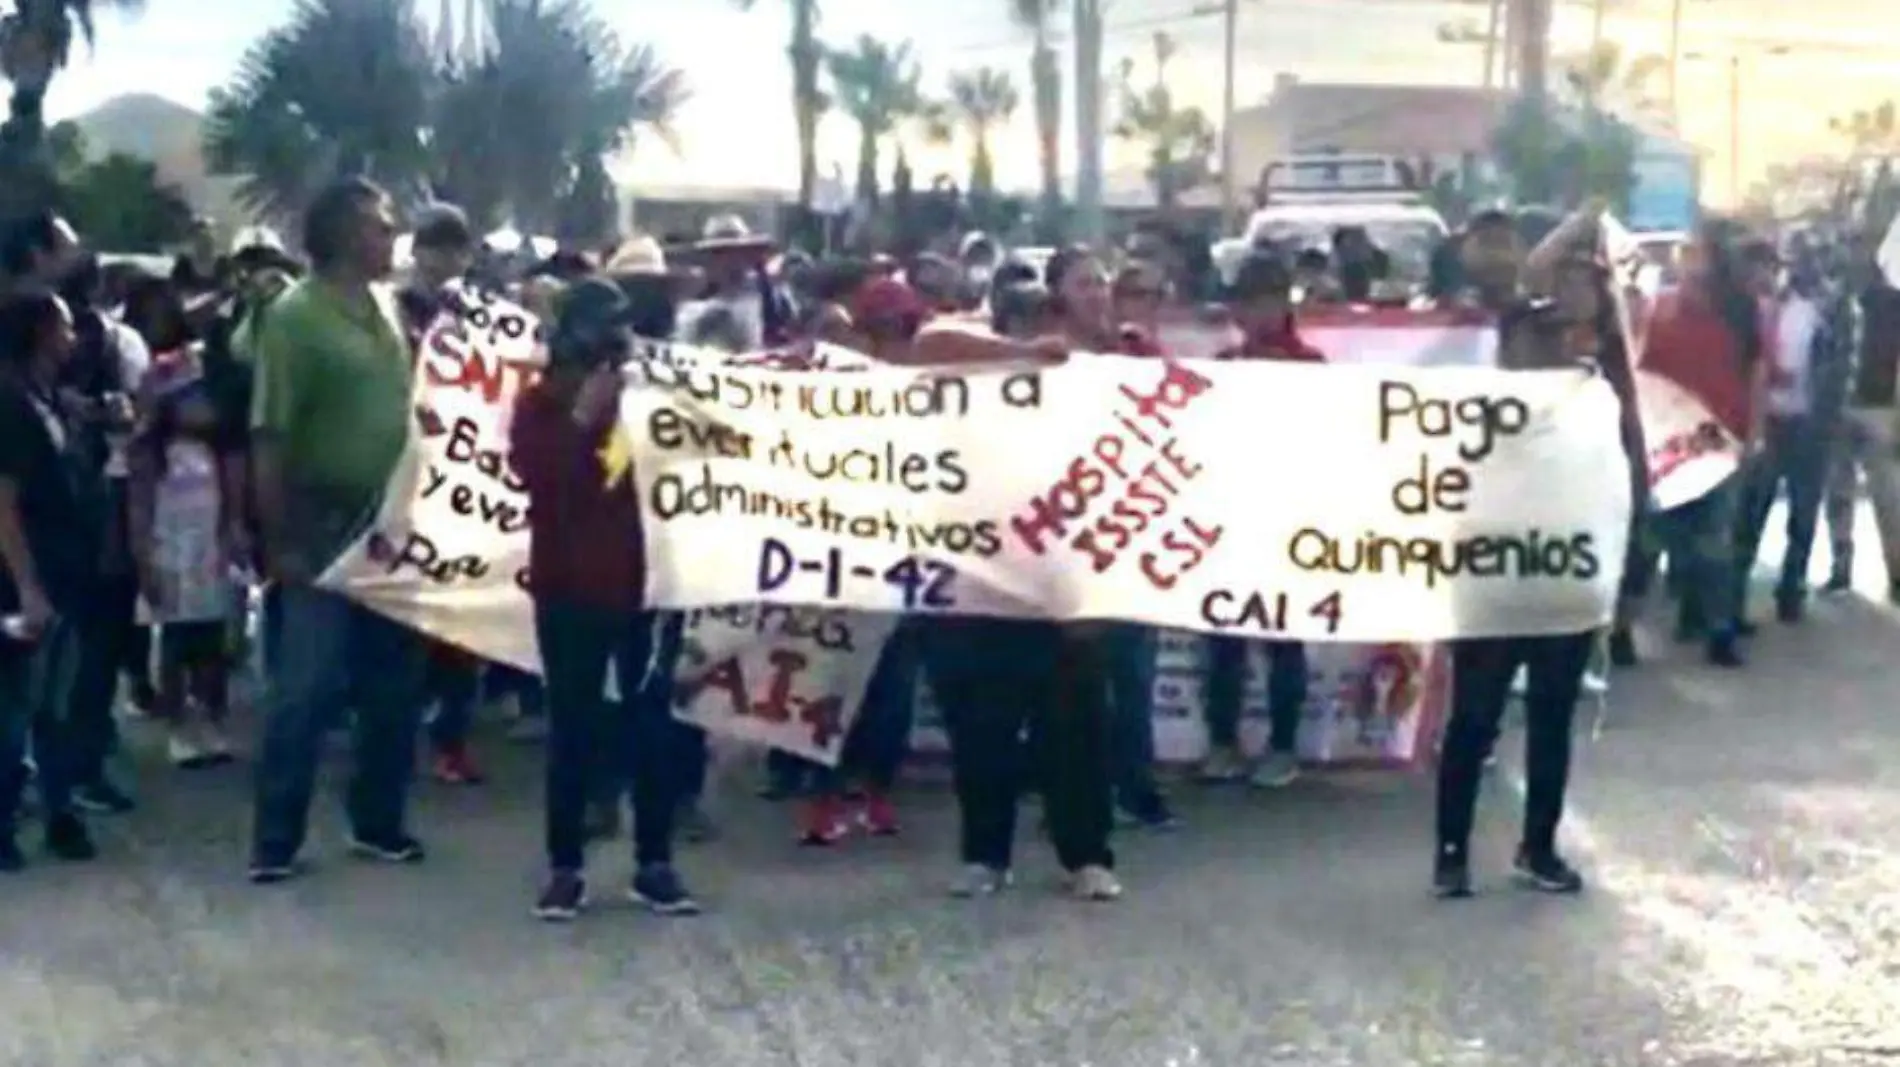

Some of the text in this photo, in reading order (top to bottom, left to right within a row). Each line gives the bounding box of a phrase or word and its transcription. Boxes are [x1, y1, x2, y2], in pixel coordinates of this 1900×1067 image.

[1001, 373, 1040, 407] a
[1379, 380, 1529, 461] Pago
[651, 463, 1001, 556] administrativos
[1071, 437, 1202, 573] ISSSTE
[1391, 454, 1469, 514] de
[1139, 516, 1224, 590] CSL
[1288, 526, 1599, 588] Quinquenios
[1201, 589, 1344, 633] CAI 4
